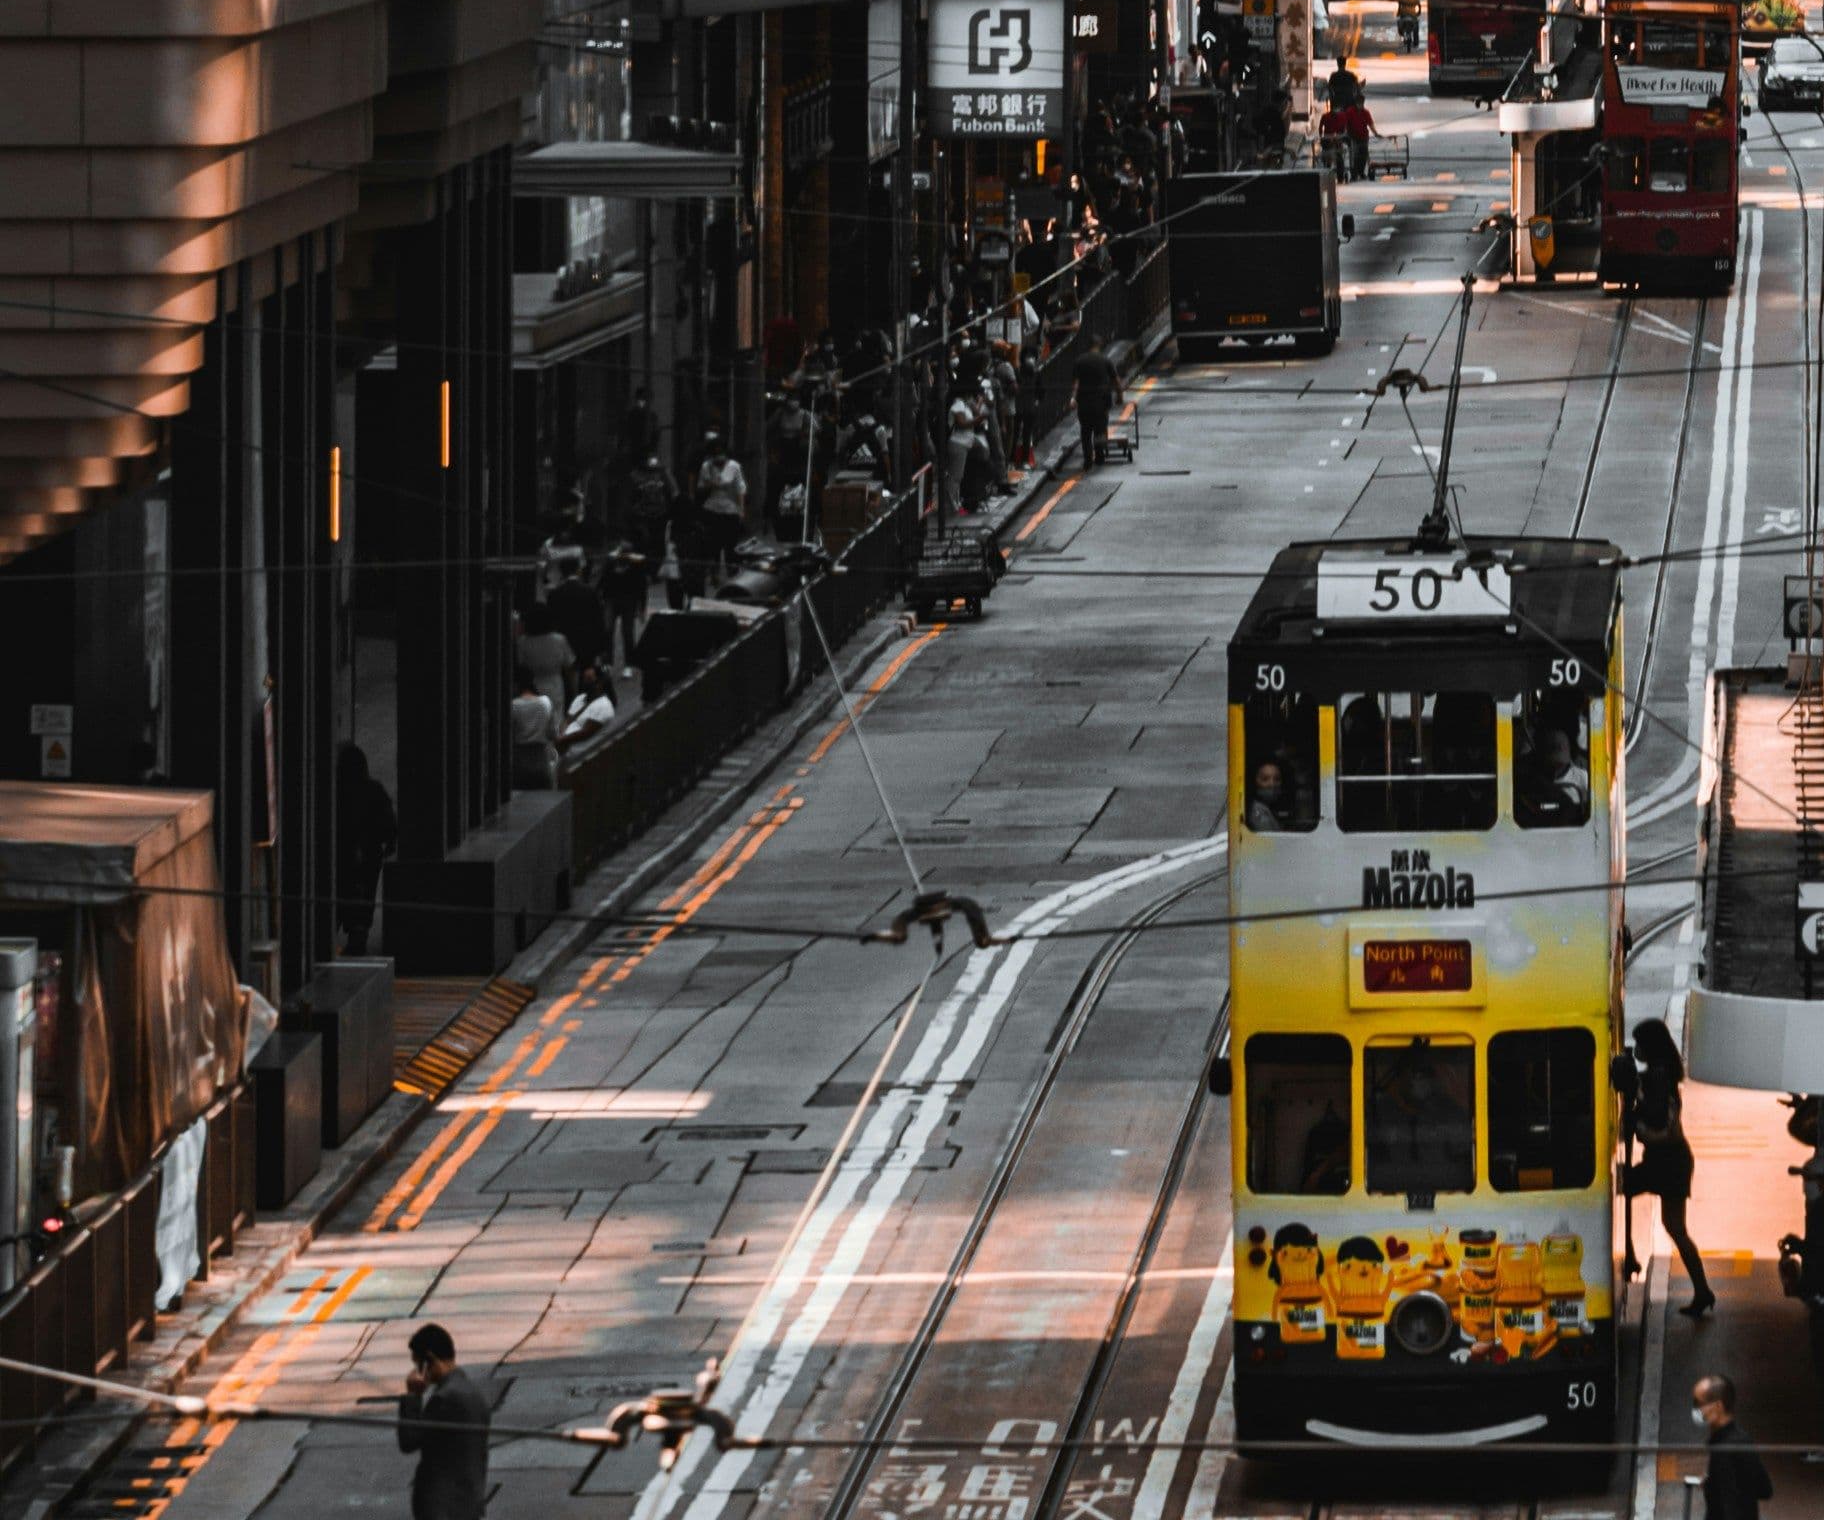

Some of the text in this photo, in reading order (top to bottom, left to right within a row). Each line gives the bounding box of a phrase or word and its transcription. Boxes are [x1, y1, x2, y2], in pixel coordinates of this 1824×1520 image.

[1626, 77, 1657, 92] Move
[952, 93, 1048, 117] 富邦銀行
[952, 118, 1046, 133] Fubon Bank
[1368, 567, 1444, 612] 50
[1256, 664, 1286, 692] 50
[1548, 659, 1581, 687] 50
[1363, 866, 1475, 910] Mazola
[1366, 944, 1416, 962] North
[1567, 1381, 1597, 1410] 50
